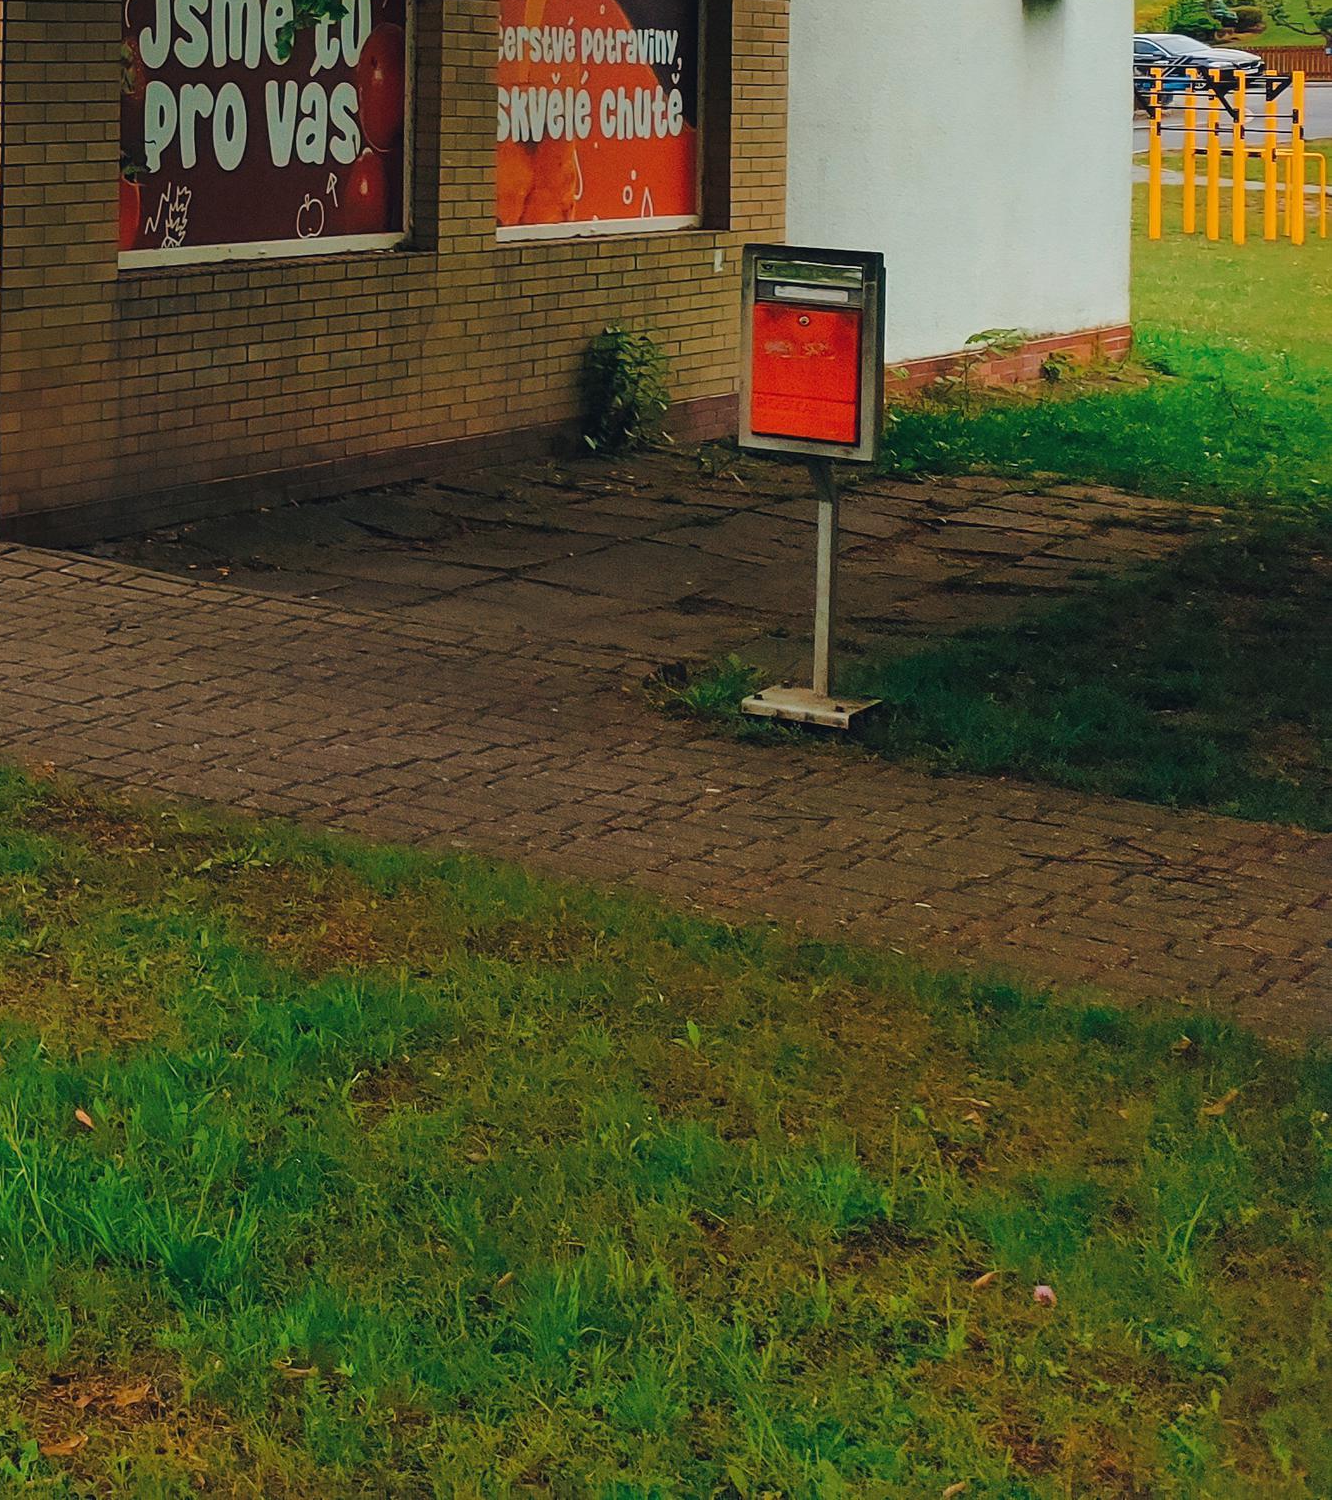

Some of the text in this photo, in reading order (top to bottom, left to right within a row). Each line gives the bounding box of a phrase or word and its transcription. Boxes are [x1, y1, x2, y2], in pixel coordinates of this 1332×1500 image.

[581, 26, 683, 71] potraviny,
[144, 80, 248, 173] pro
[599, 72, 684, 141] chutě
